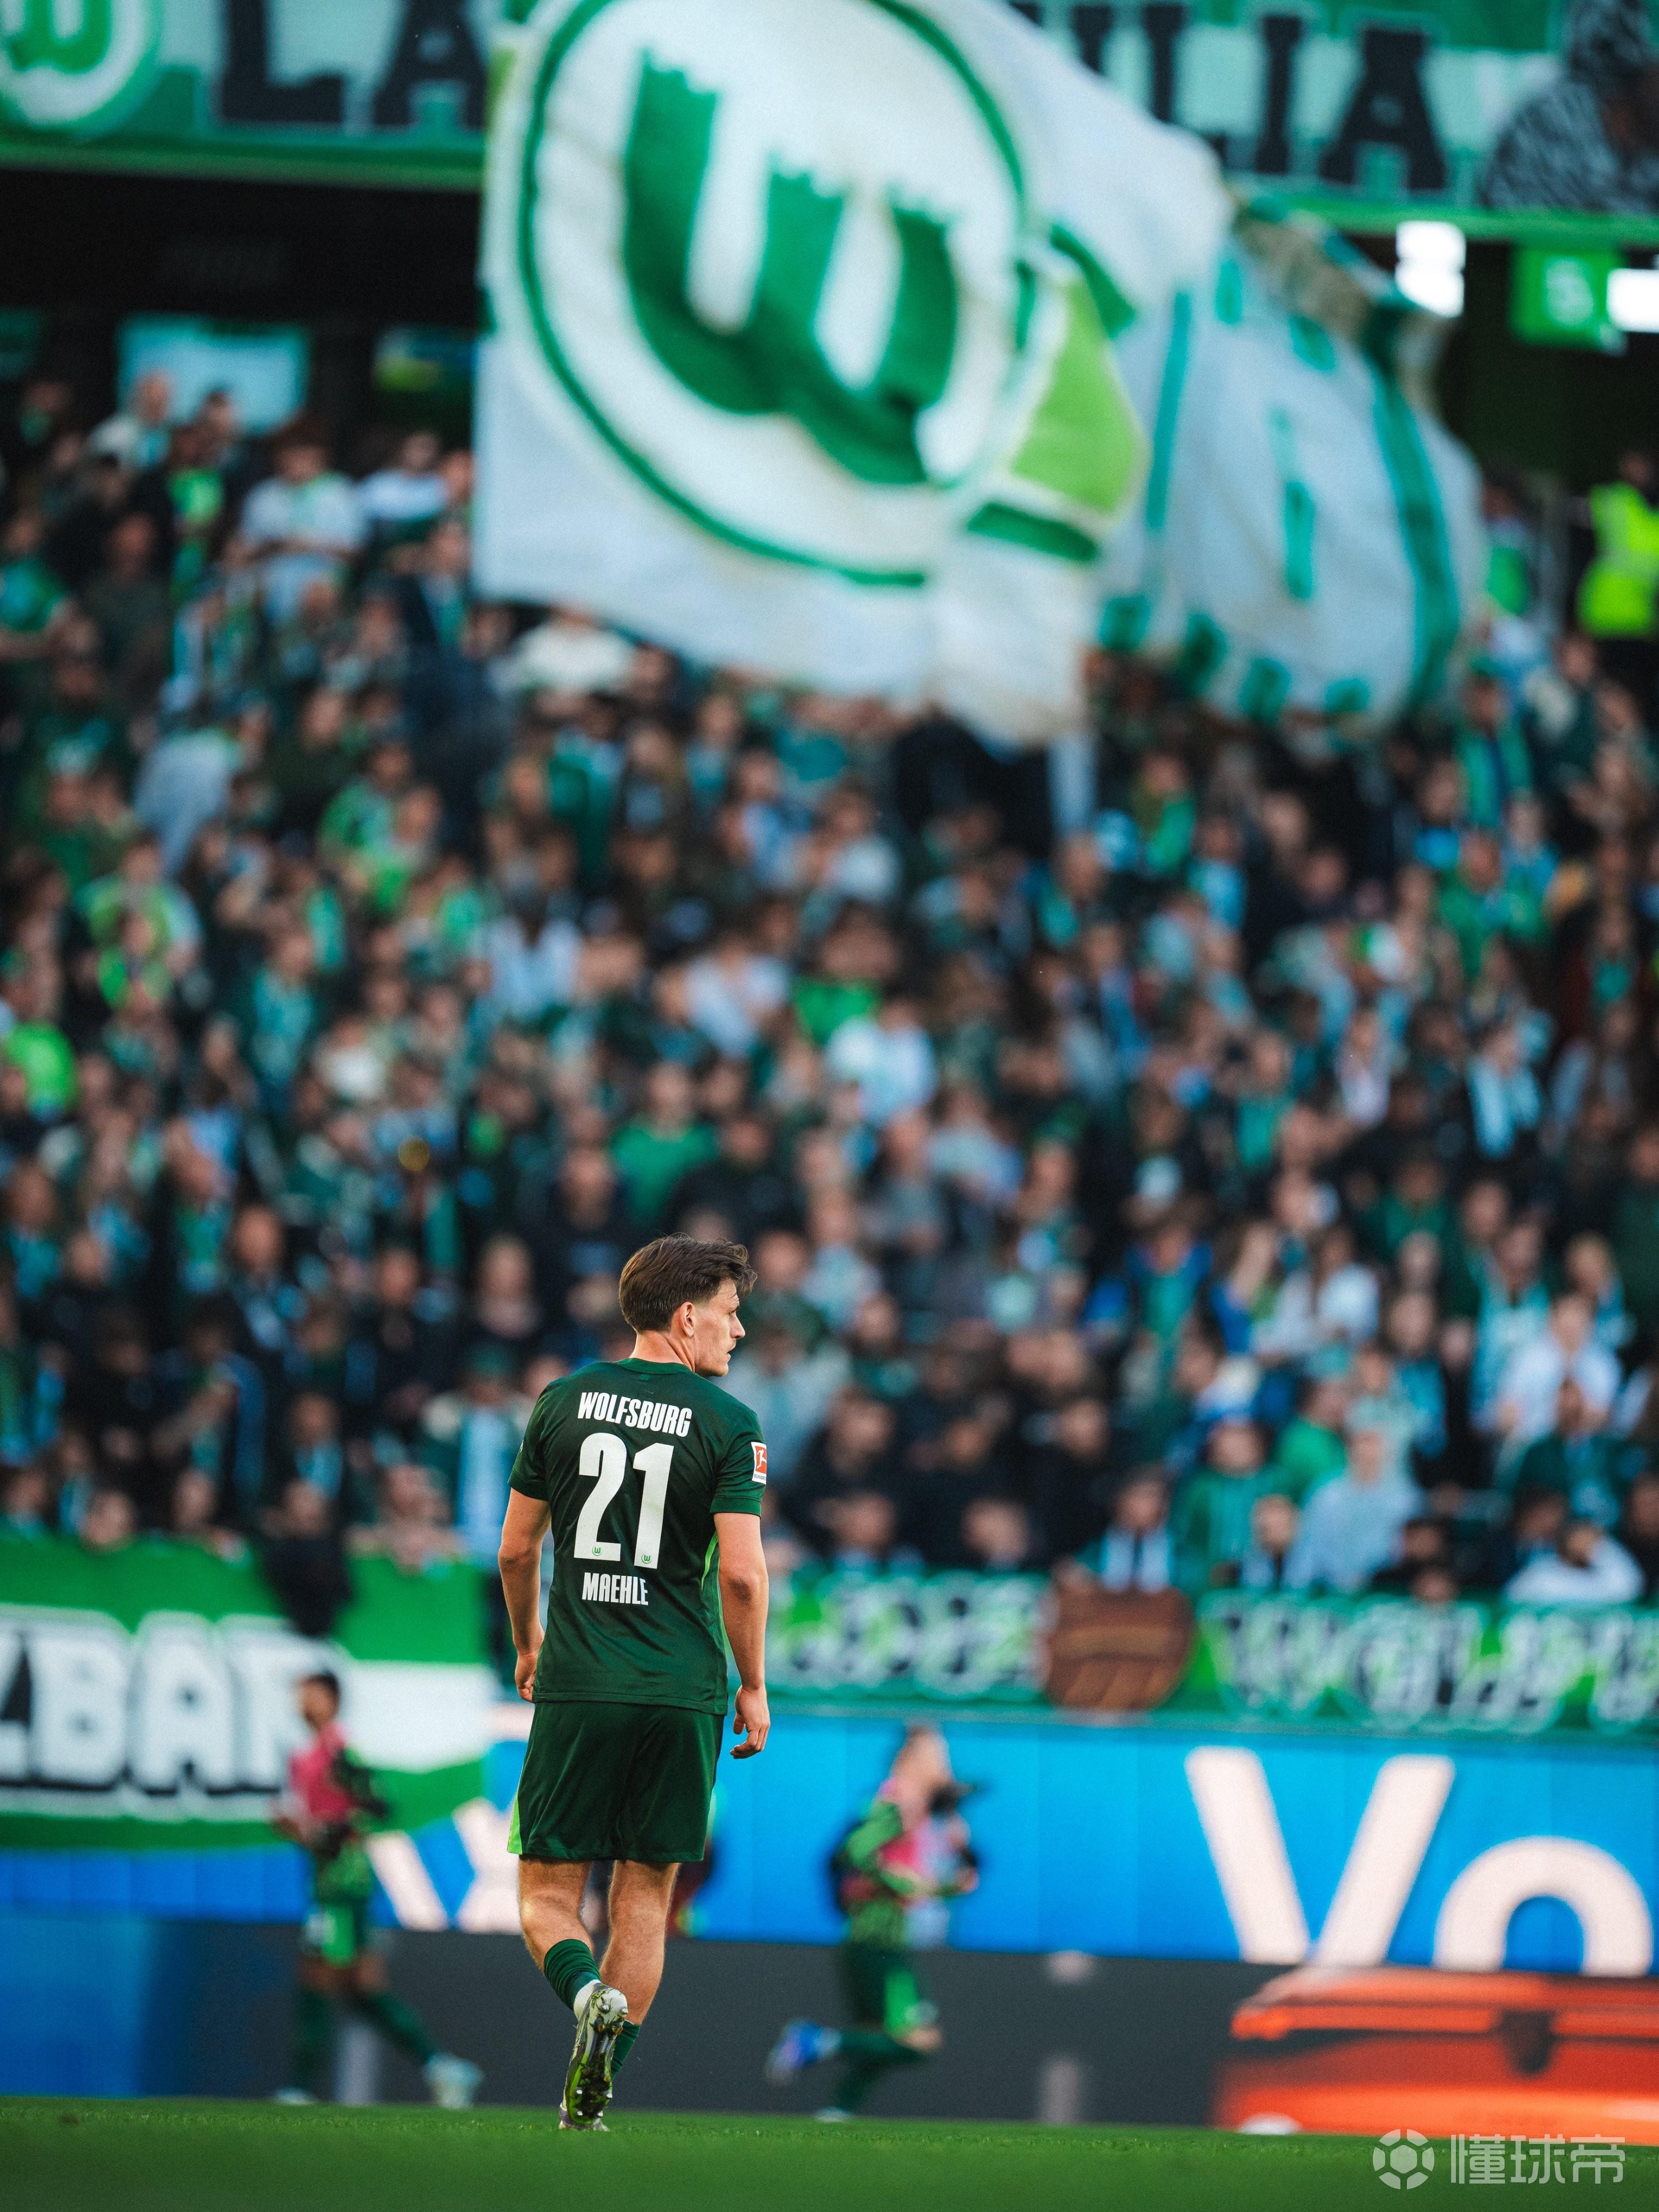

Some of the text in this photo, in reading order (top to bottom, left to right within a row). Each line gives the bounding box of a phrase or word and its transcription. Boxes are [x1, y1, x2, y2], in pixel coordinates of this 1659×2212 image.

[577, 1392, 692, 1437] WOLFSBURG
[574, 1432, 675, 1569] 21
[582, 1572, 648, 1605] MAEHLE
